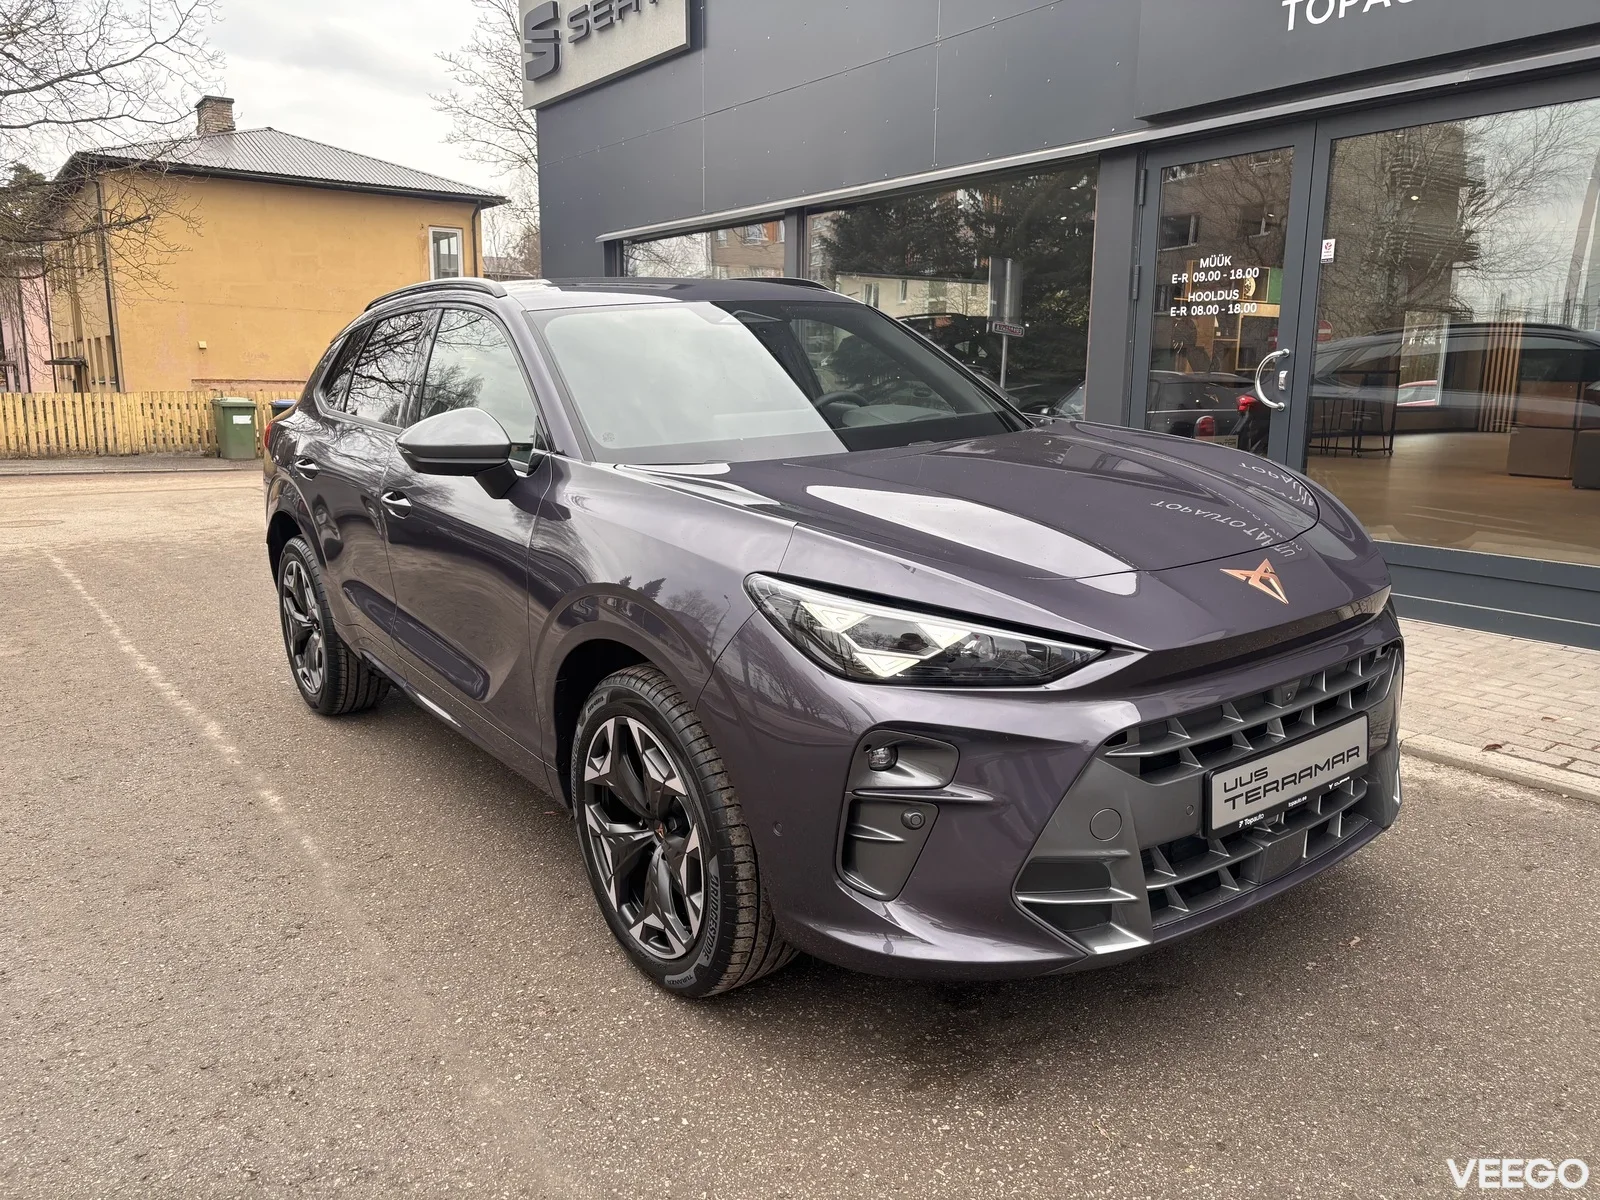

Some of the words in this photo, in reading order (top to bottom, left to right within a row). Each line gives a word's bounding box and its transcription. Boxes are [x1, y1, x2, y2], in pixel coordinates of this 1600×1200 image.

[567, 0, 657, 43] SEA
[1200, 254, 1232, 269] MÜÜK
[1171, 273, 1189, 284] E-R
[1192, 270, 1221, 283] 09.00
[1229, 267, 1260, 280] 18.00
[1188, 289, 1240, 303] HOOLDUS
[1170, 306, 1187, 317] E-R
[1190, 304, 1219, 316] 08.00
[1227, 303, 1258, 314] 18.00
[1223, 745, 1360, 811] TERRAMAR
[1223, 766, 1269, 794] UUS
[1244, 813, 1265, 826] Topauto
[703, 873, 720, 961] BRIDGESTONE
